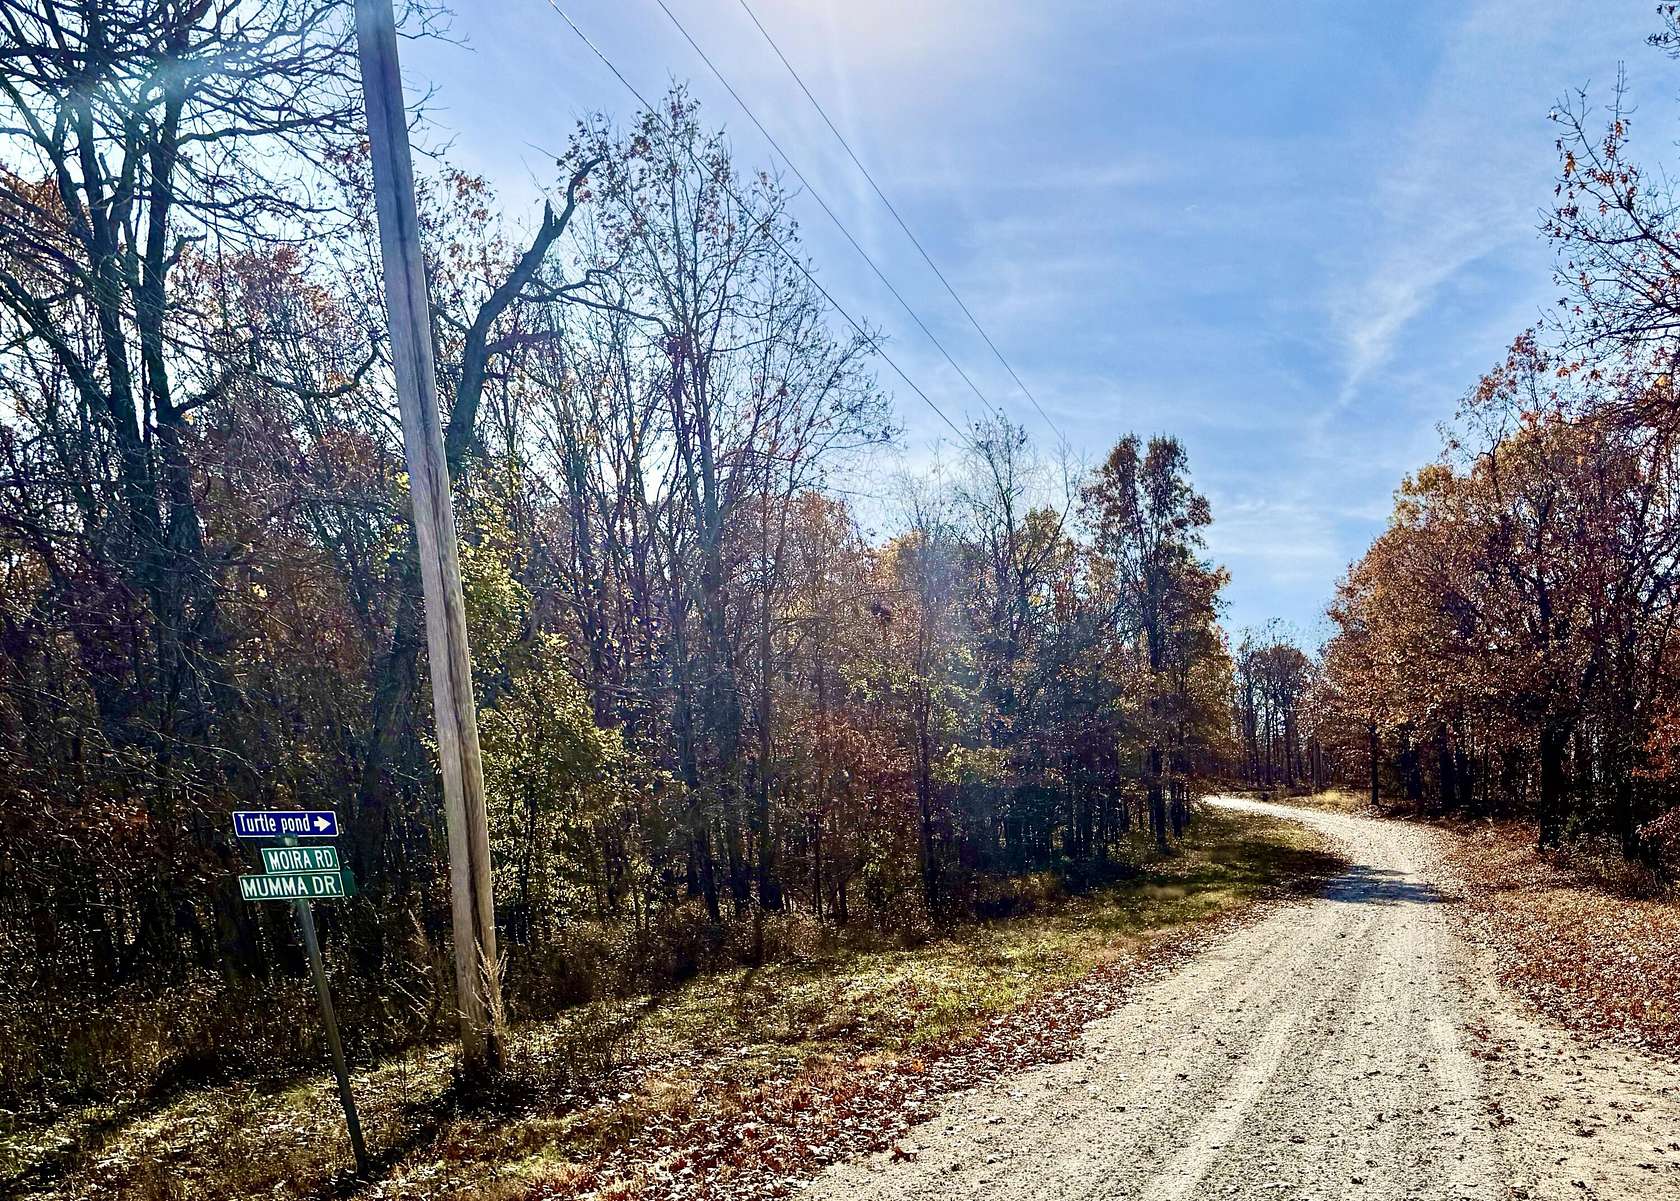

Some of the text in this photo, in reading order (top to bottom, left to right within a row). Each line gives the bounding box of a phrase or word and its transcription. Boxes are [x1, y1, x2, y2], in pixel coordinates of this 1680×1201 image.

[238, 813, 311, 834] Turtle pond
[268, 849, 337, 871] MOIRA RD.
[242, 875, 341, 897] MUMMA DR.
